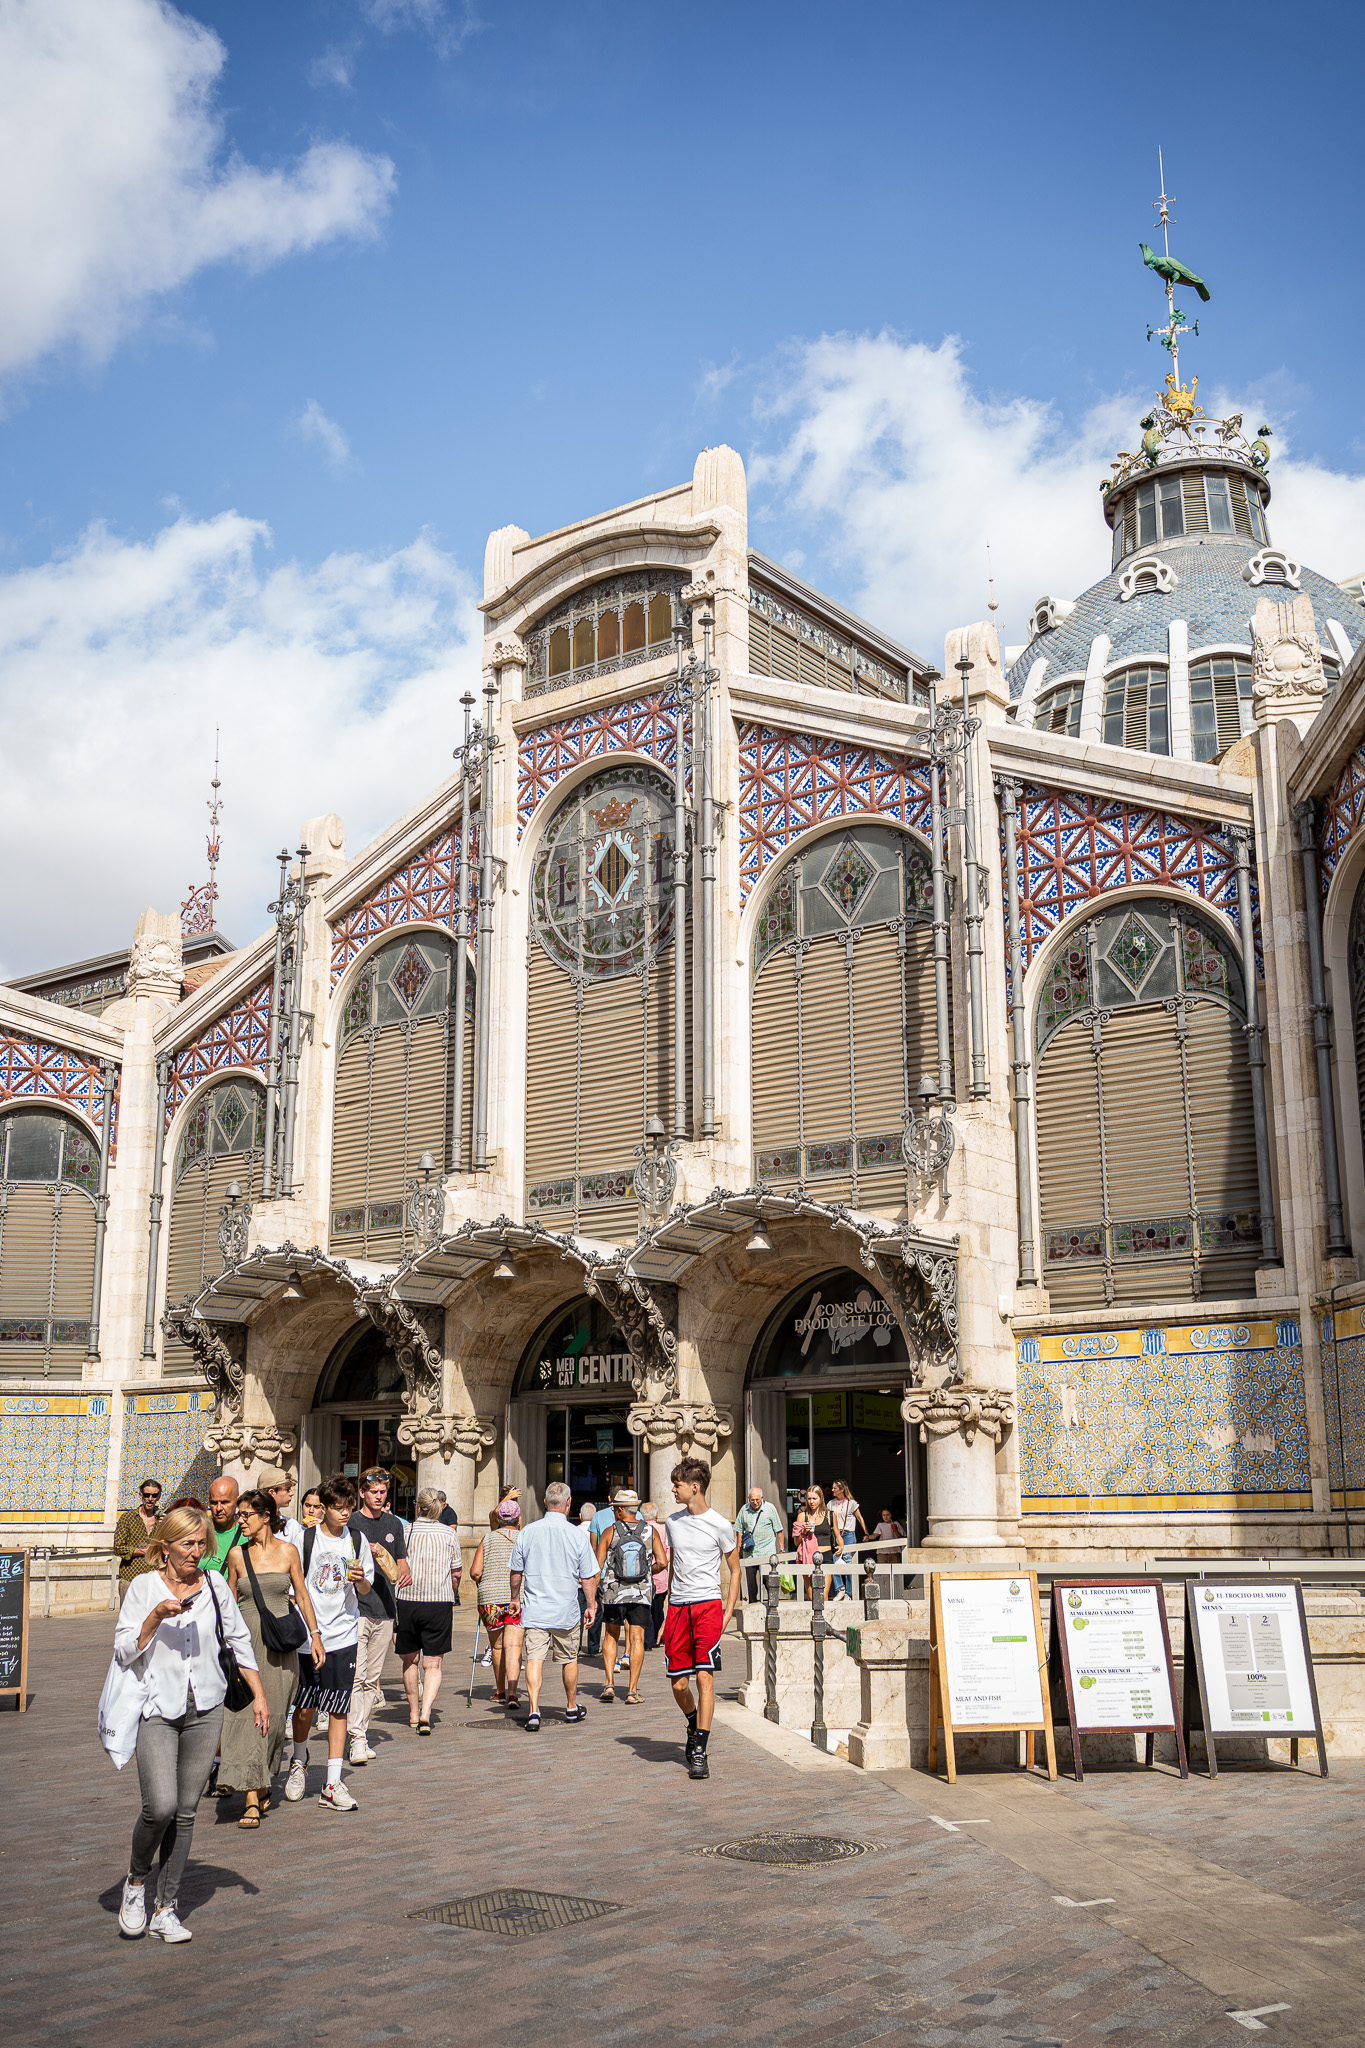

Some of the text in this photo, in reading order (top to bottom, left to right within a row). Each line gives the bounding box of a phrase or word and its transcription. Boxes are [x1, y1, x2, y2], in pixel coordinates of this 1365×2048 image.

[815, 1300, 891, 1317] CONSUMIX
[794, 1313, 899, 1332] PRODUCTE LOC
[556, 1357, 575, 1372] MER
[558, 1371, 575, 1386] CAT
